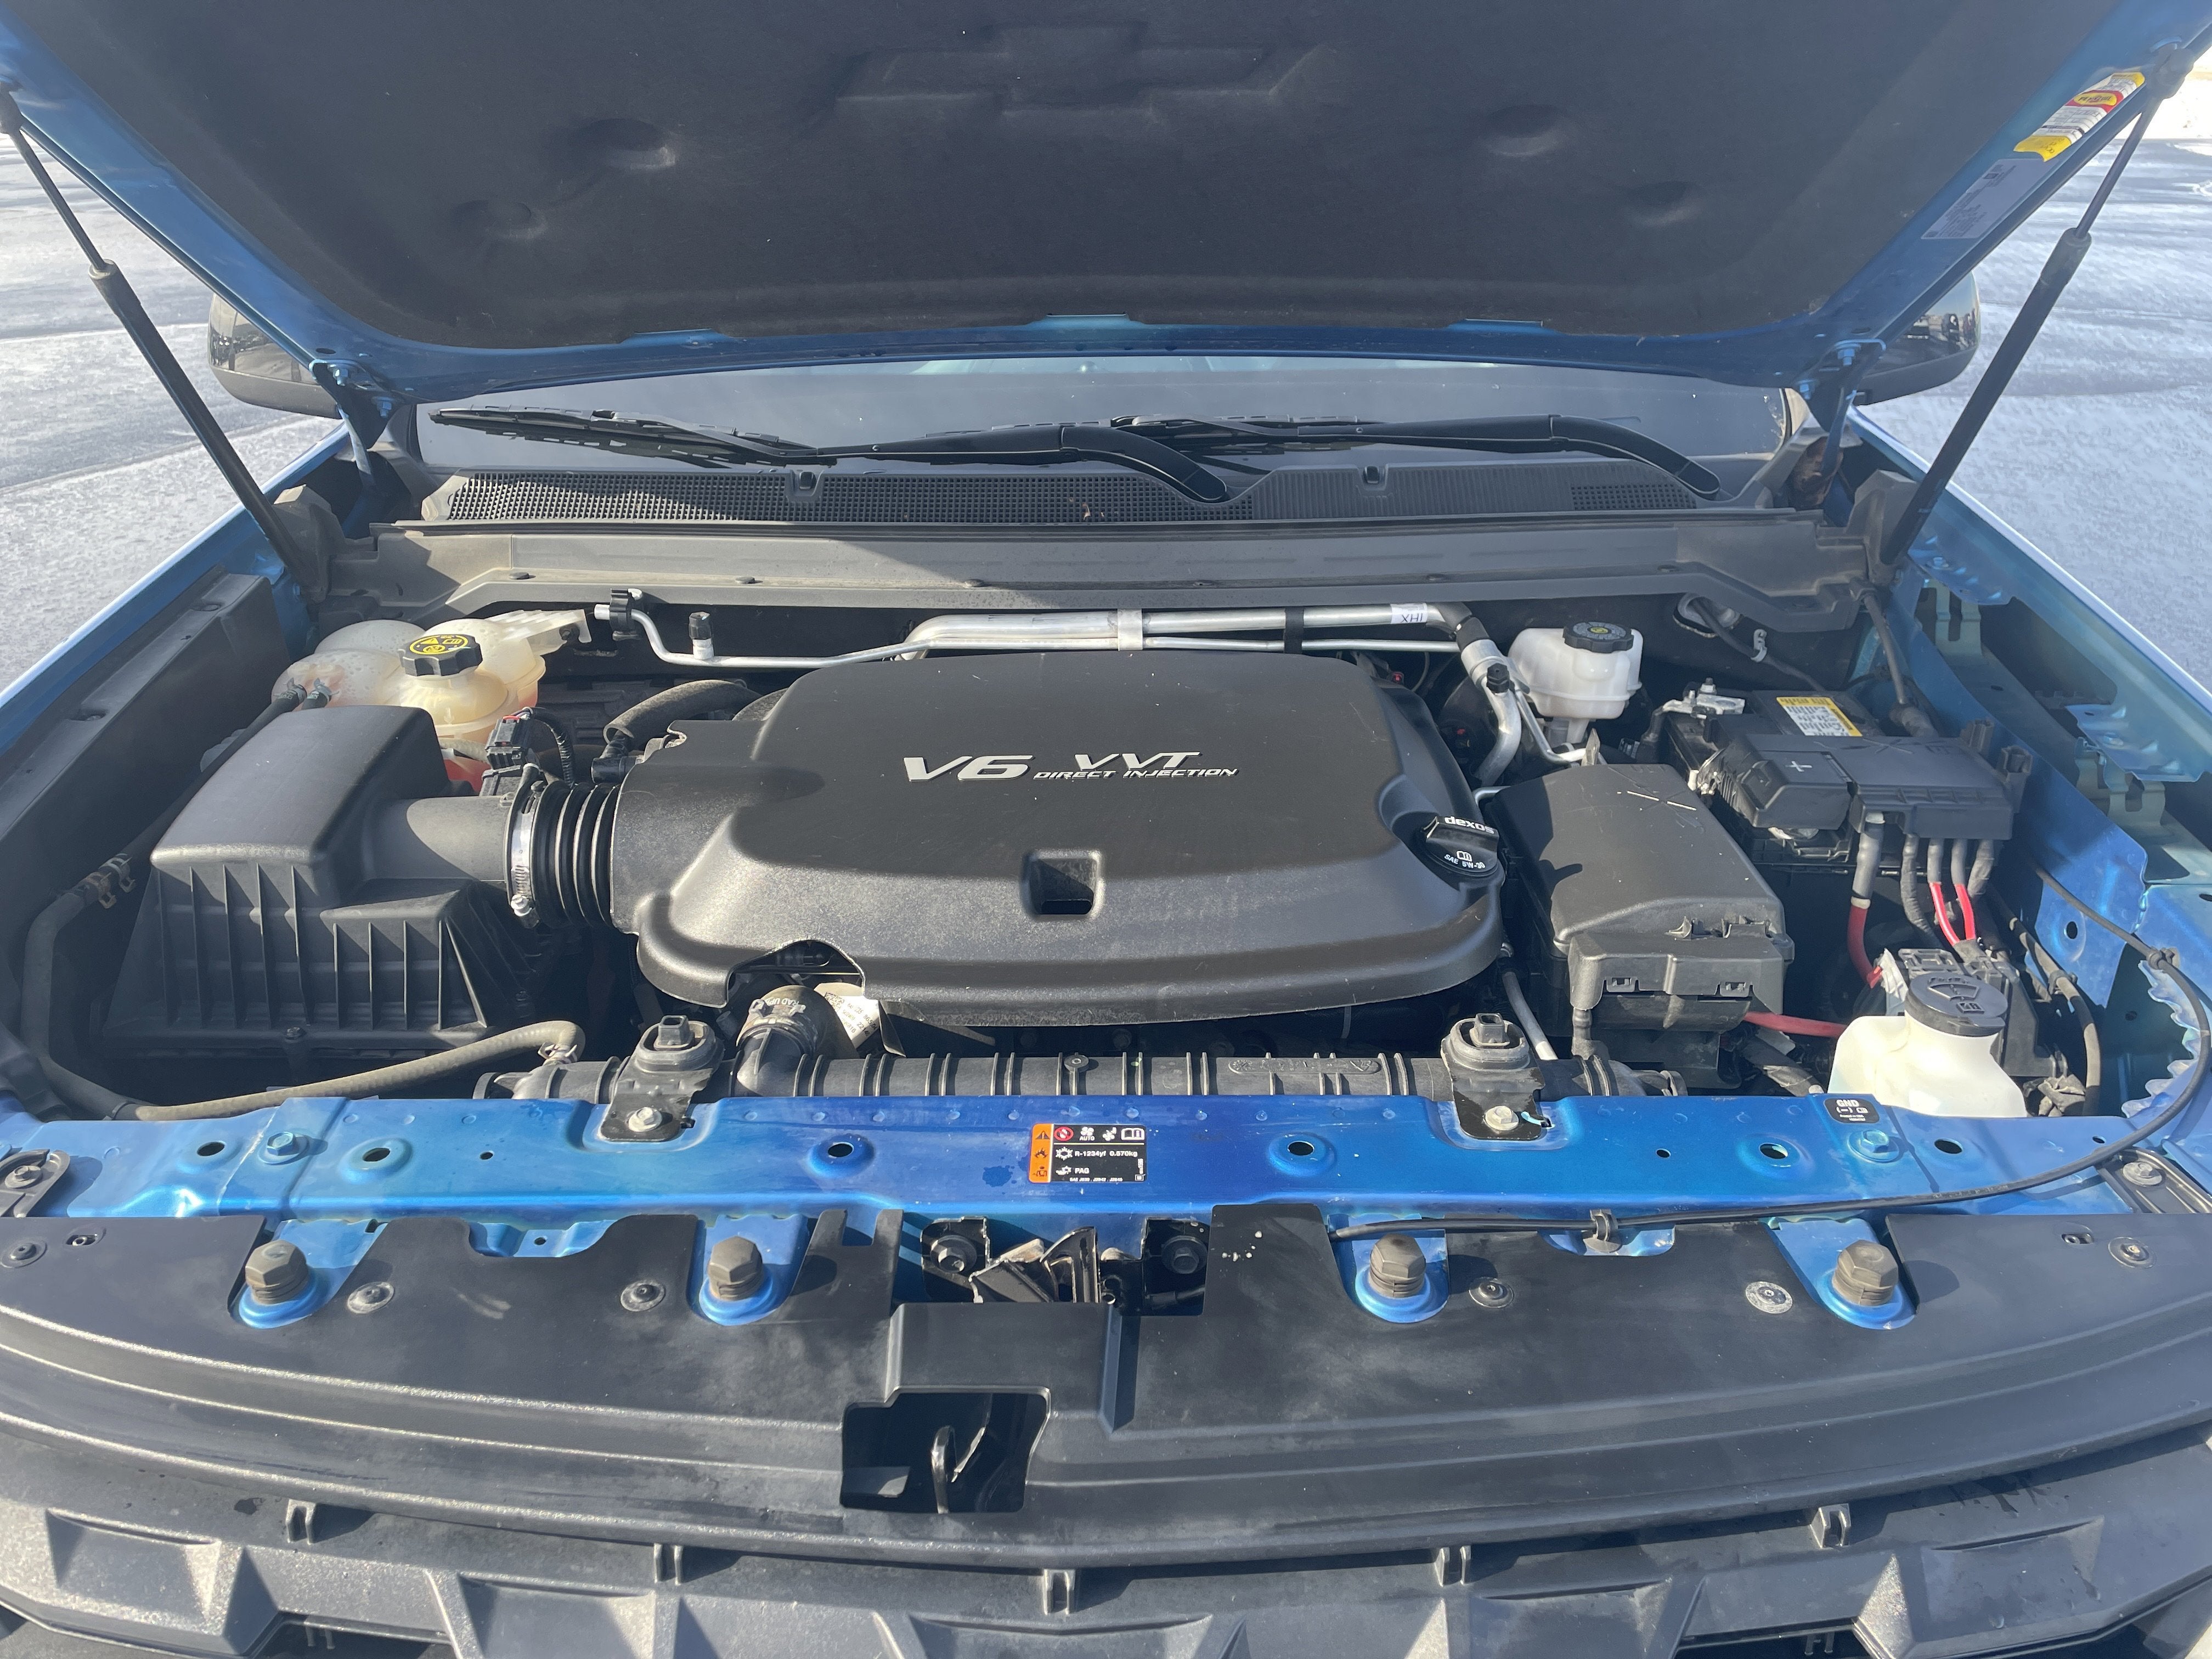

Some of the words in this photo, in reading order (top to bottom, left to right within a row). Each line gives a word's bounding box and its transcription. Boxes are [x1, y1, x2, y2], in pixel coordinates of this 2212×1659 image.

[904, 755, 1034, 781] V6
[1074, 752, 1201, 770] VVT
[1034, 770, 1116, 780] DIRECT
[1123, 769, 1238, 779] INJECTION
[1444, 816, 1495, 834] dexos
[1444, 854, 1459, 865] SAE
[1462, 861, 1486, 869] 5W-30
